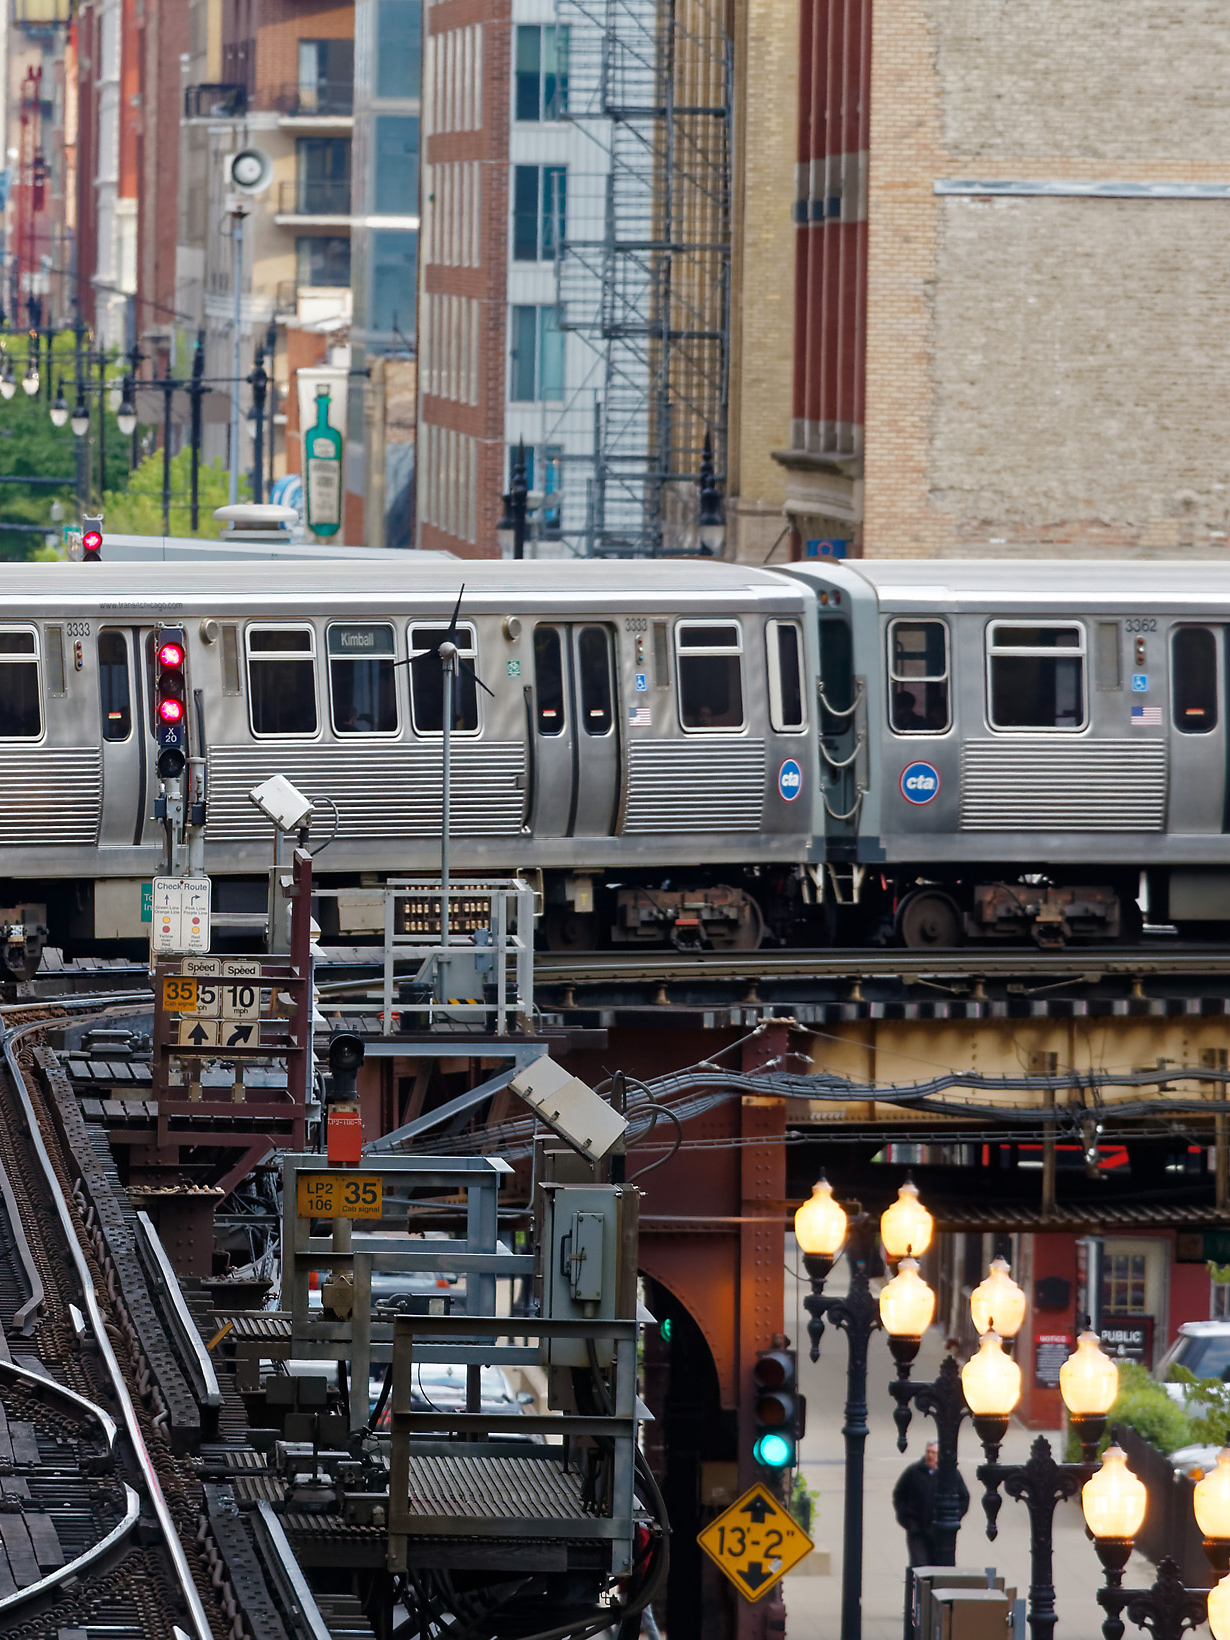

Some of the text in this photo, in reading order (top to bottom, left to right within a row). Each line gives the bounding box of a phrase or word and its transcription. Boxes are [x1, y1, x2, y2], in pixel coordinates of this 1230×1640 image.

[99, 602, 183, 611] www.transitchicago.com
[67, 622, 90, 636] 3333
[625, 618, 647, 631] 3333
[1125, 618, 1157, 632] 3362
[341, 632, 374, 646] Kimball
[168, 727, 174, 735] X
[165, 735, 177, 743] 20
[781, 771, 799, 787] cta
[906, 775, 935, 790] cta
[157, 882, 207, 891] Check Route
[187, 963, 215, 972] Speed
[228, 966, 255, 975] Speed
[166, 982, 193, 999] 35
[227, 986, 254, 1007] 10
[307, 1183, 333, 1194] LP2
[344, 1182, 377, 1204] 35
[308, 1199, 332, 1210] 106
[358, 1206, 380, 1214] signal
[1101, 1330, 1141, 1342] PUBLIC
[1117, 1344, 1126, 1356] &
